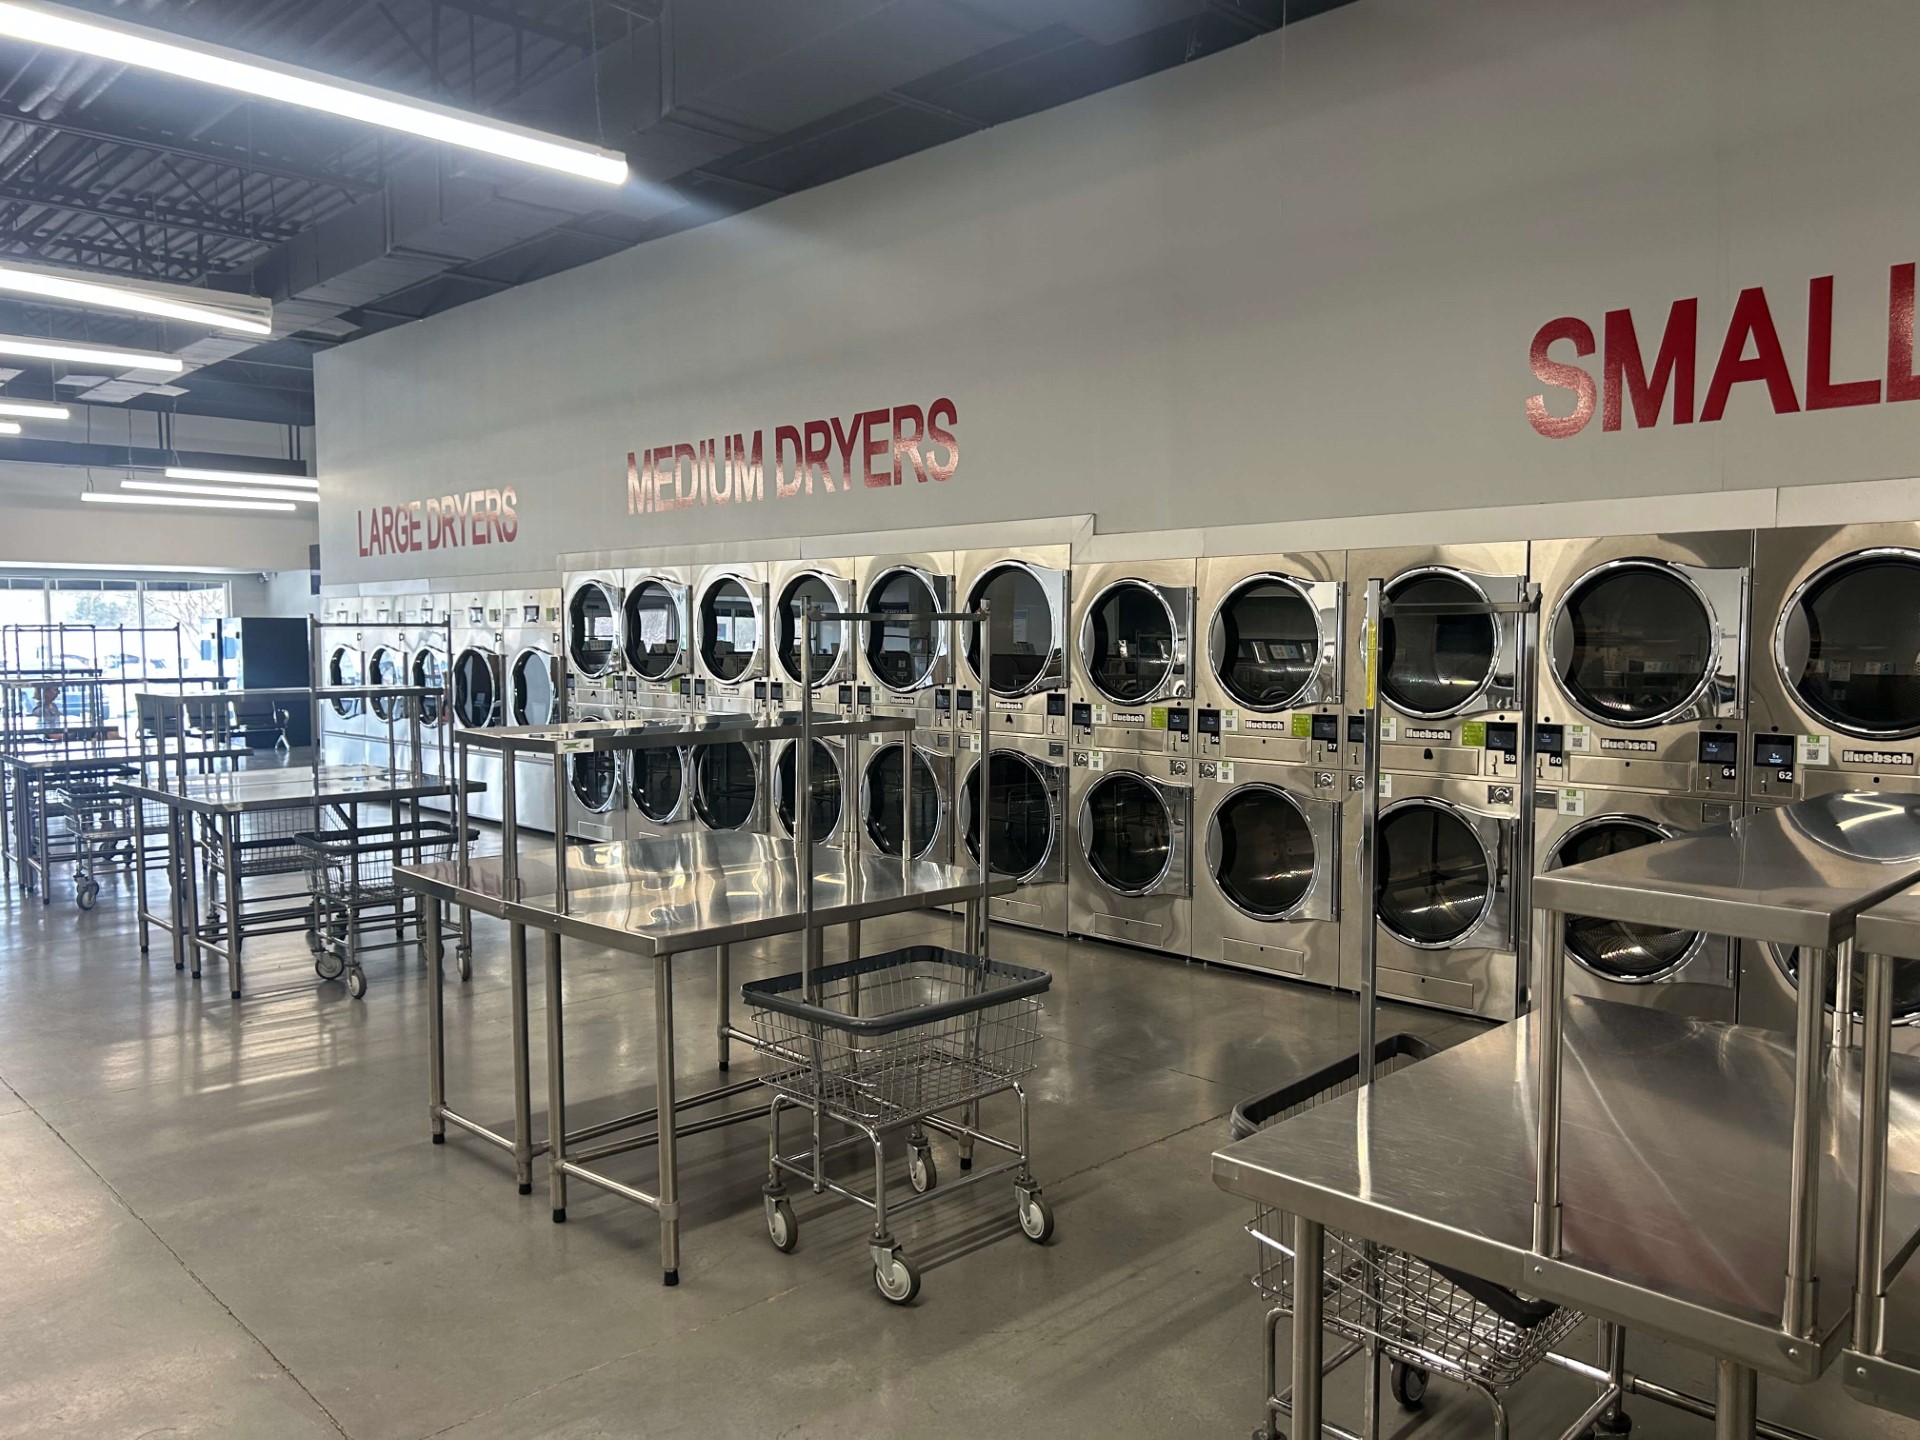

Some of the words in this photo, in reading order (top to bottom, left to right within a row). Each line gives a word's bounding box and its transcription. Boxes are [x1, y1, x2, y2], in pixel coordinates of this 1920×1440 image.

[627, 430, 764, 515] MEDIUM
[774, 398, 960, 500] DRYERS
[358, 500, 421, 557] LARGE
[427, 485, 518, 550] DRYERS
[1112, 713, 1145, 722] Huebsch
[1246, 720, 1284, 730] Huebsch
[1406, 729, 1451, 739] Huebsch
[1601, 739, 1656, 750] Huebsch
[1550, 757, 1562, 765] 60
[1843, 751, 1912, 764] Huebsch
[1723, 768, 1735, 776] 61
[1779, 771, 1792, 779] 62
